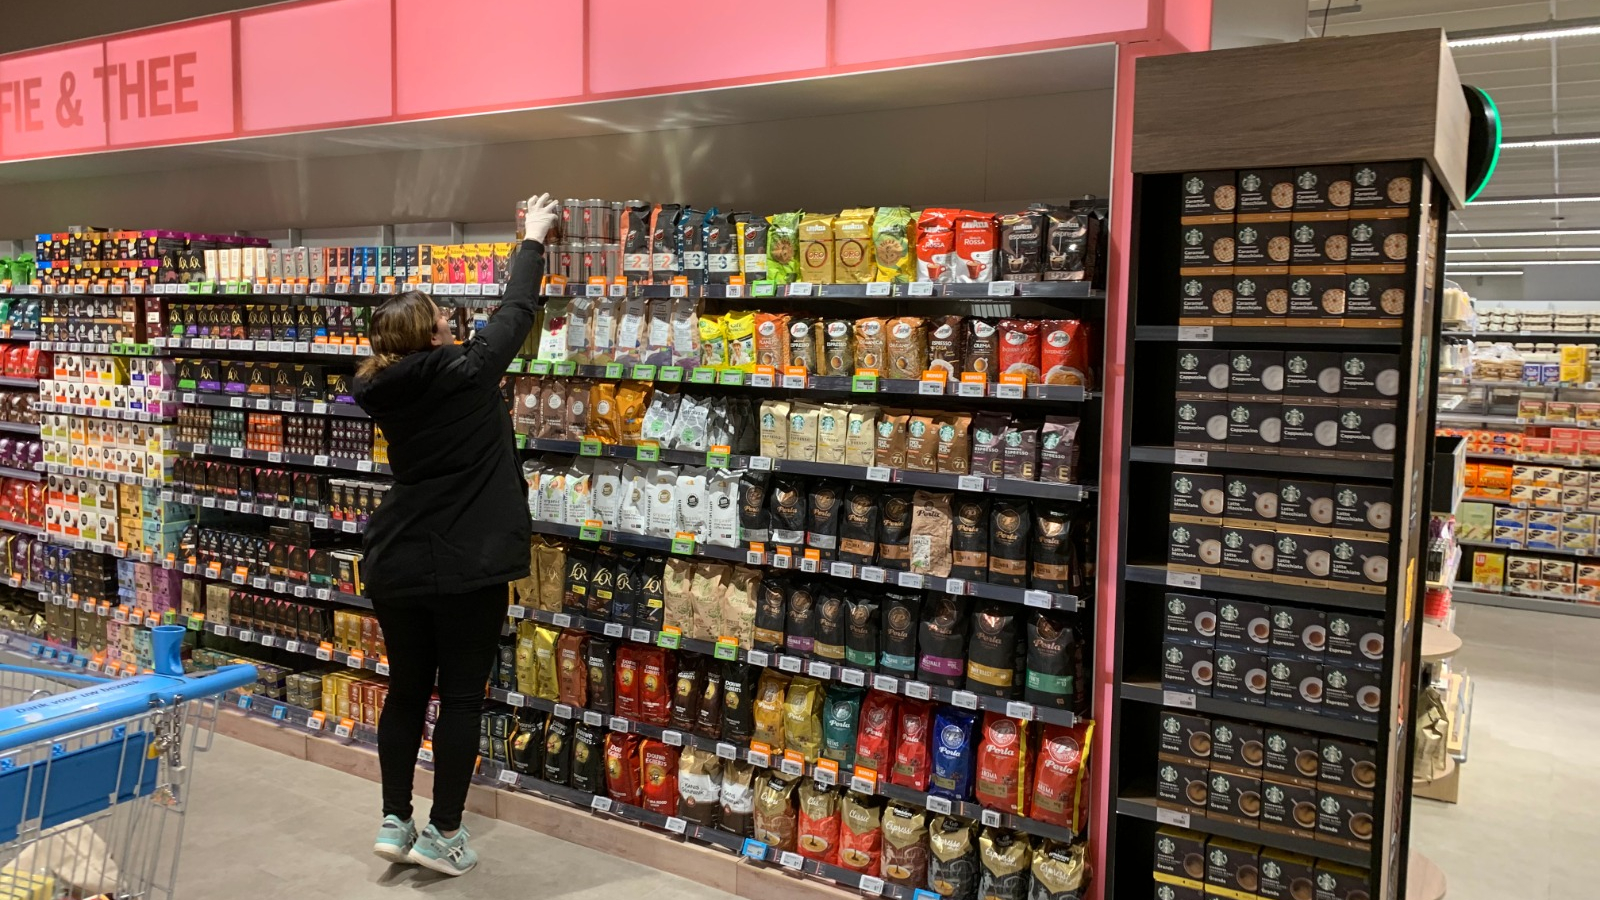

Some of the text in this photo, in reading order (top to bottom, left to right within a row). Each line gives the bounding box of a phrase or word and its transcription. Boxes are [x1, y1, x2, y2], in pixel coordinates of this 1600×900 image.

[56, 71, 83, 128] &
[93, 52, 198, 122] THEE
[962, 220, 988, 229] LAVAZZA
[632, 256, 641, 268] 2
[661, 256, 671, 268] 2
[692, 254, 701, 267] 3
[718, 256, 727, 269] 3
[893, 456, 903, 464] 71
[922, 457, 934, 465] 71
[954, 460, 965, 468] 71
[992, 462, 1001, 472] E
[1023, 464, 1032, 475] E
[1059, 467, 1068, 478] E
[814, 509, 831, 517] Perla
[917, 510, 941, 518] Perla
[848, 514, 868, 522] Perla
[883, 519, 904, 527] Perla
[957, 524, 979, 532] Perla
[996, 531, 1018, 540] Perla
[568, 562, 588, 581] L'OR
[592, 567, 612, 587] L'OR
[643, 574, 663, 595] L'OR
[850, 625, 868, 634] Perla
[888, 629, 908, 638] Perla
[977, 633, 1002, 644] Perla
[1219, 632, 1241, 640] Espresso
[1033, 640, 1061, 651] Perla
[1273, 639, 1295, 648] Espresso
[1328, 647, 1352, 655] Espresso
[1165, 673, 1185, 682] Espresso
[724, 685, 741, 693] EGBERTS
[1217, 682, 1238, 690] Espresso
[1270, 690, 1292, 699] Espresso
[16, 703, 49, 714] Dank
[51, 695, 78, 704] voor
[81, 690, 98, 698] uw
[758, 702, 775, 710] Perla
[1326, 699, 1349, 707] Espresso
[788, 713, 804, 722] Perla
[829, 720, 850, 728] Perla
[576, 728, 593, 738] DOUWE
[865, 727, 883, 737] Perla
[576, 734, 592, 744] EGBERTS
[902, 734, 919, 743] Perla
[939, 746, 961, 757] Perla
[986, 744, 1014, 756] Perla
[646, 752, 666, 761] DOUWE
[787, 752, 801, 760] BONUS
[1214, 752, 1232, 760] Grande
[645, 758, 667, 767] EGBERTS
[1045, 759, 1073, 774] Perla
[1267, 762, 1285, 770] Grande
[981, 771, 997, 779] AROMA
[1321, 772, 1341, 781] Grande
[1038, 784, 1054, 795] AROMA
[1159, 791, 1176, 799] Grande
[1210, 802, 1229, 810] Grande
[849, 810, 869, 822] Classic
[1264, 813, 1283, 822] Grande
[886, 820, 914, 835] Espresso
[1319, 824, 1338, 833] Grande
[985, 847, 1015, 863] Espresso
[1157, 863, 1174, 871] Grande
[1209, 875, 1226, 884] Grande
[1261, 888, 1280, 897] Grande
